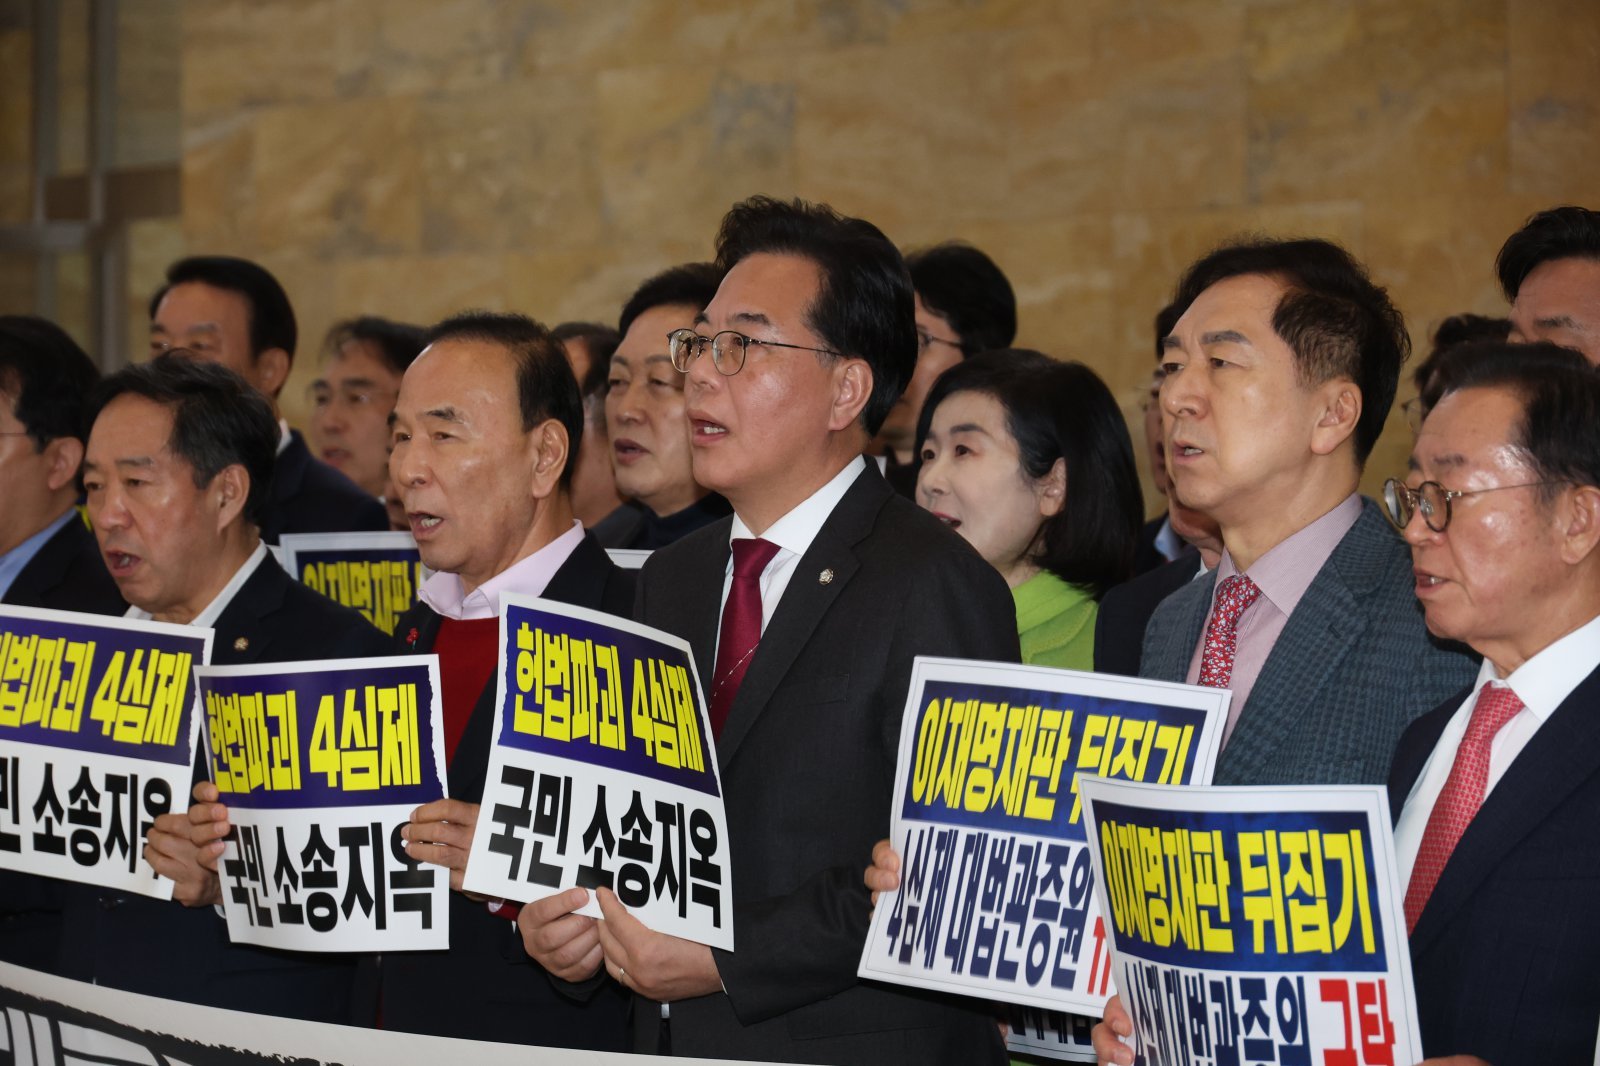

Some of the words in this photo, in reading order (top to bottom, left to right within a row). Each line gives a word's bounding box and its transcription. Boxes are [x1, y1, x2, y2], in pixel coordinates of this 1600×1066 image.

[0, 631, 96, 733] 법파괴
[90, 649, 192, 746] 4심제
[206, 690, 301, 793] 헌법파괴
[309, 683, 421, 791] 4심제
[513, 622, 626, 752] 헌법파괴
[631, 658, 705, 773] 4심제
[911, 697, 1074, 821] 이재명재판
[222, 824, 274, 928] 국민
[273, 821, 435, 933] 소송지옥
[487, 764, 573, 889] 국민
[575, 784, 722, 930] 소송지옥
[886, 826, 960, 970] 4심제
[944, 831, 1095, 991] 대법관증원
[1101, 820, 1234, 953] 이재명재판
[1237, 829, 1376, 954] 뒤집기
